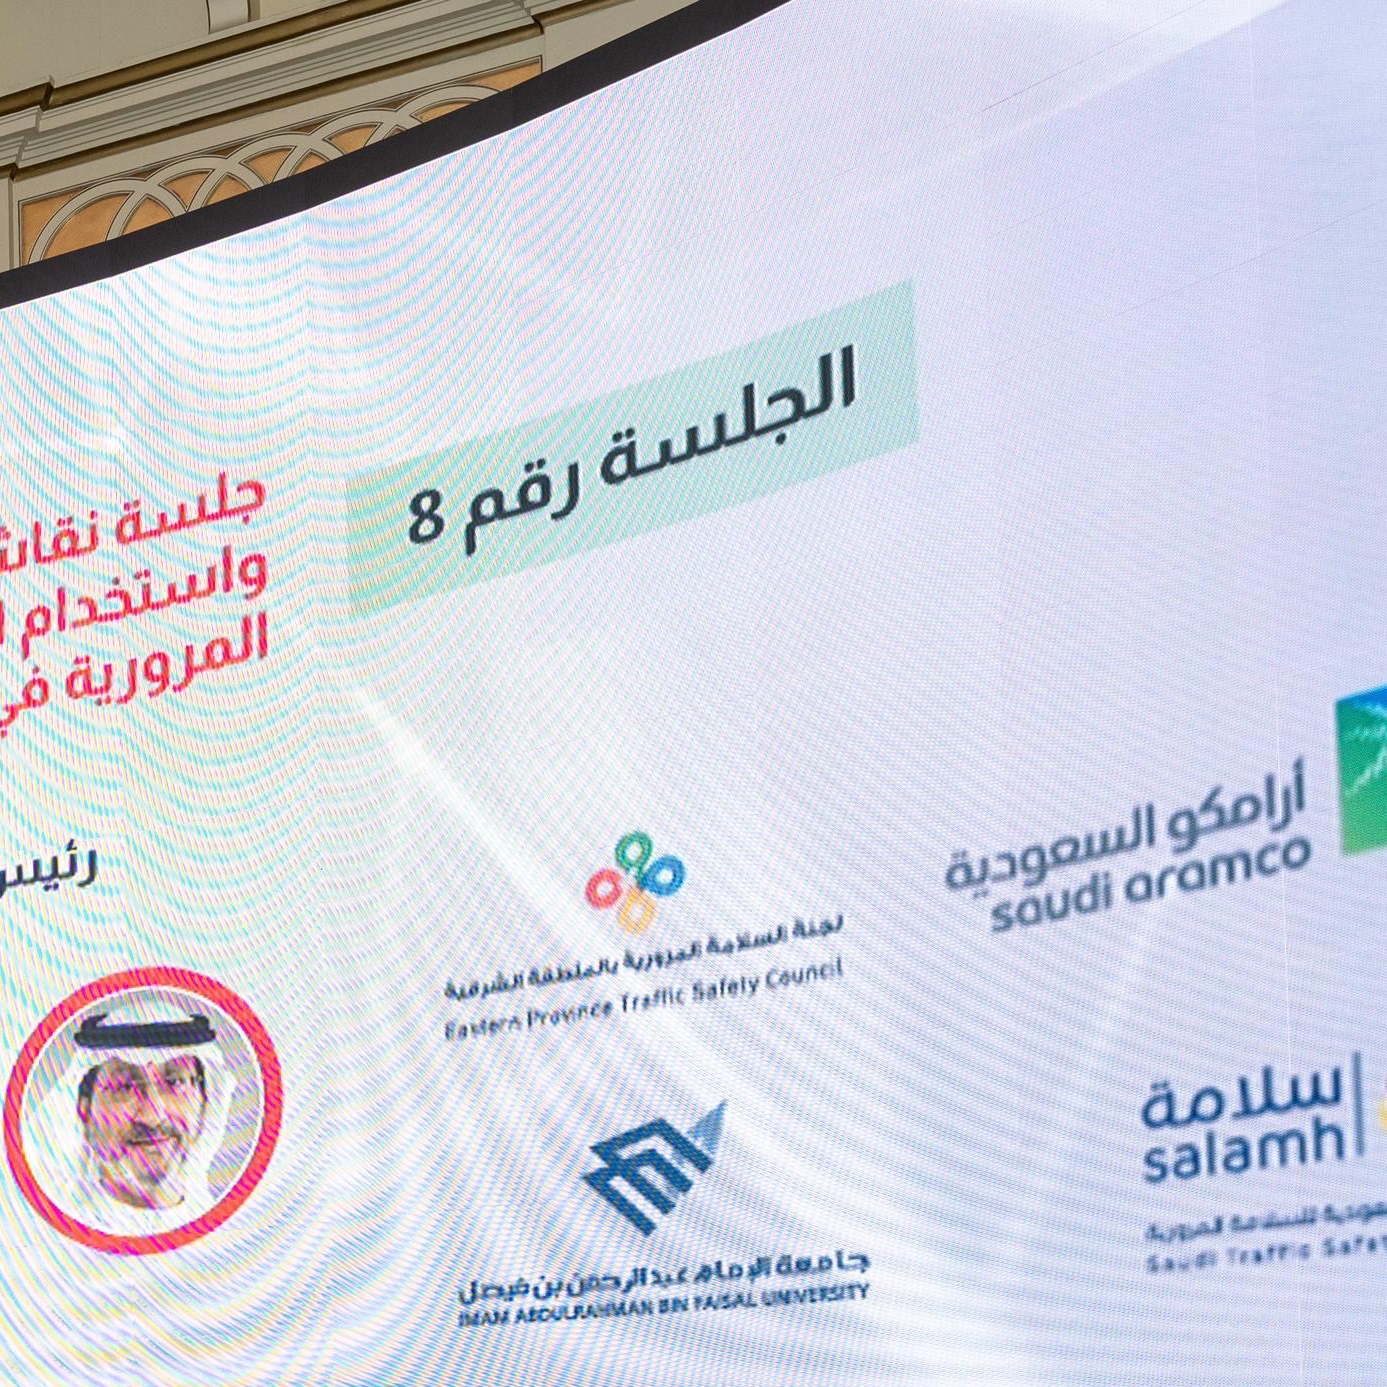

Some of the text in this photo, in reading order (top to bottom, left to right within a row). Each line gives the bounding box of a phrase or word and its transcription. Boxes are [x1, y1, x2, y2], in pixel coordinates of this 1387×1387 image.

[408, 343, 856, 556] الجلسة رقم 8
[115, 472, 266, 544] جلسة
[22, 545, 267, 660] واستخدام
[65, 611, 267, 706] المرورية
[944, 755, 1305, 898] أرامكو السعودية
[991, 835, 1312, 934] saudi aramco
[445, 956, 844, 1041] Eastern Province Traffic Safety Council
[1141, 1064, 1342, 1129] سلامة
[1144, 1115, 1345, 1184] salamh
[658, 1296, 689, 1314] BIN
[693, 1291, 758, 1311] FAISAL
[761, 1282, 871, 1307] UNIVERSITY
[776, 1248, 871, 1277] جامعة
